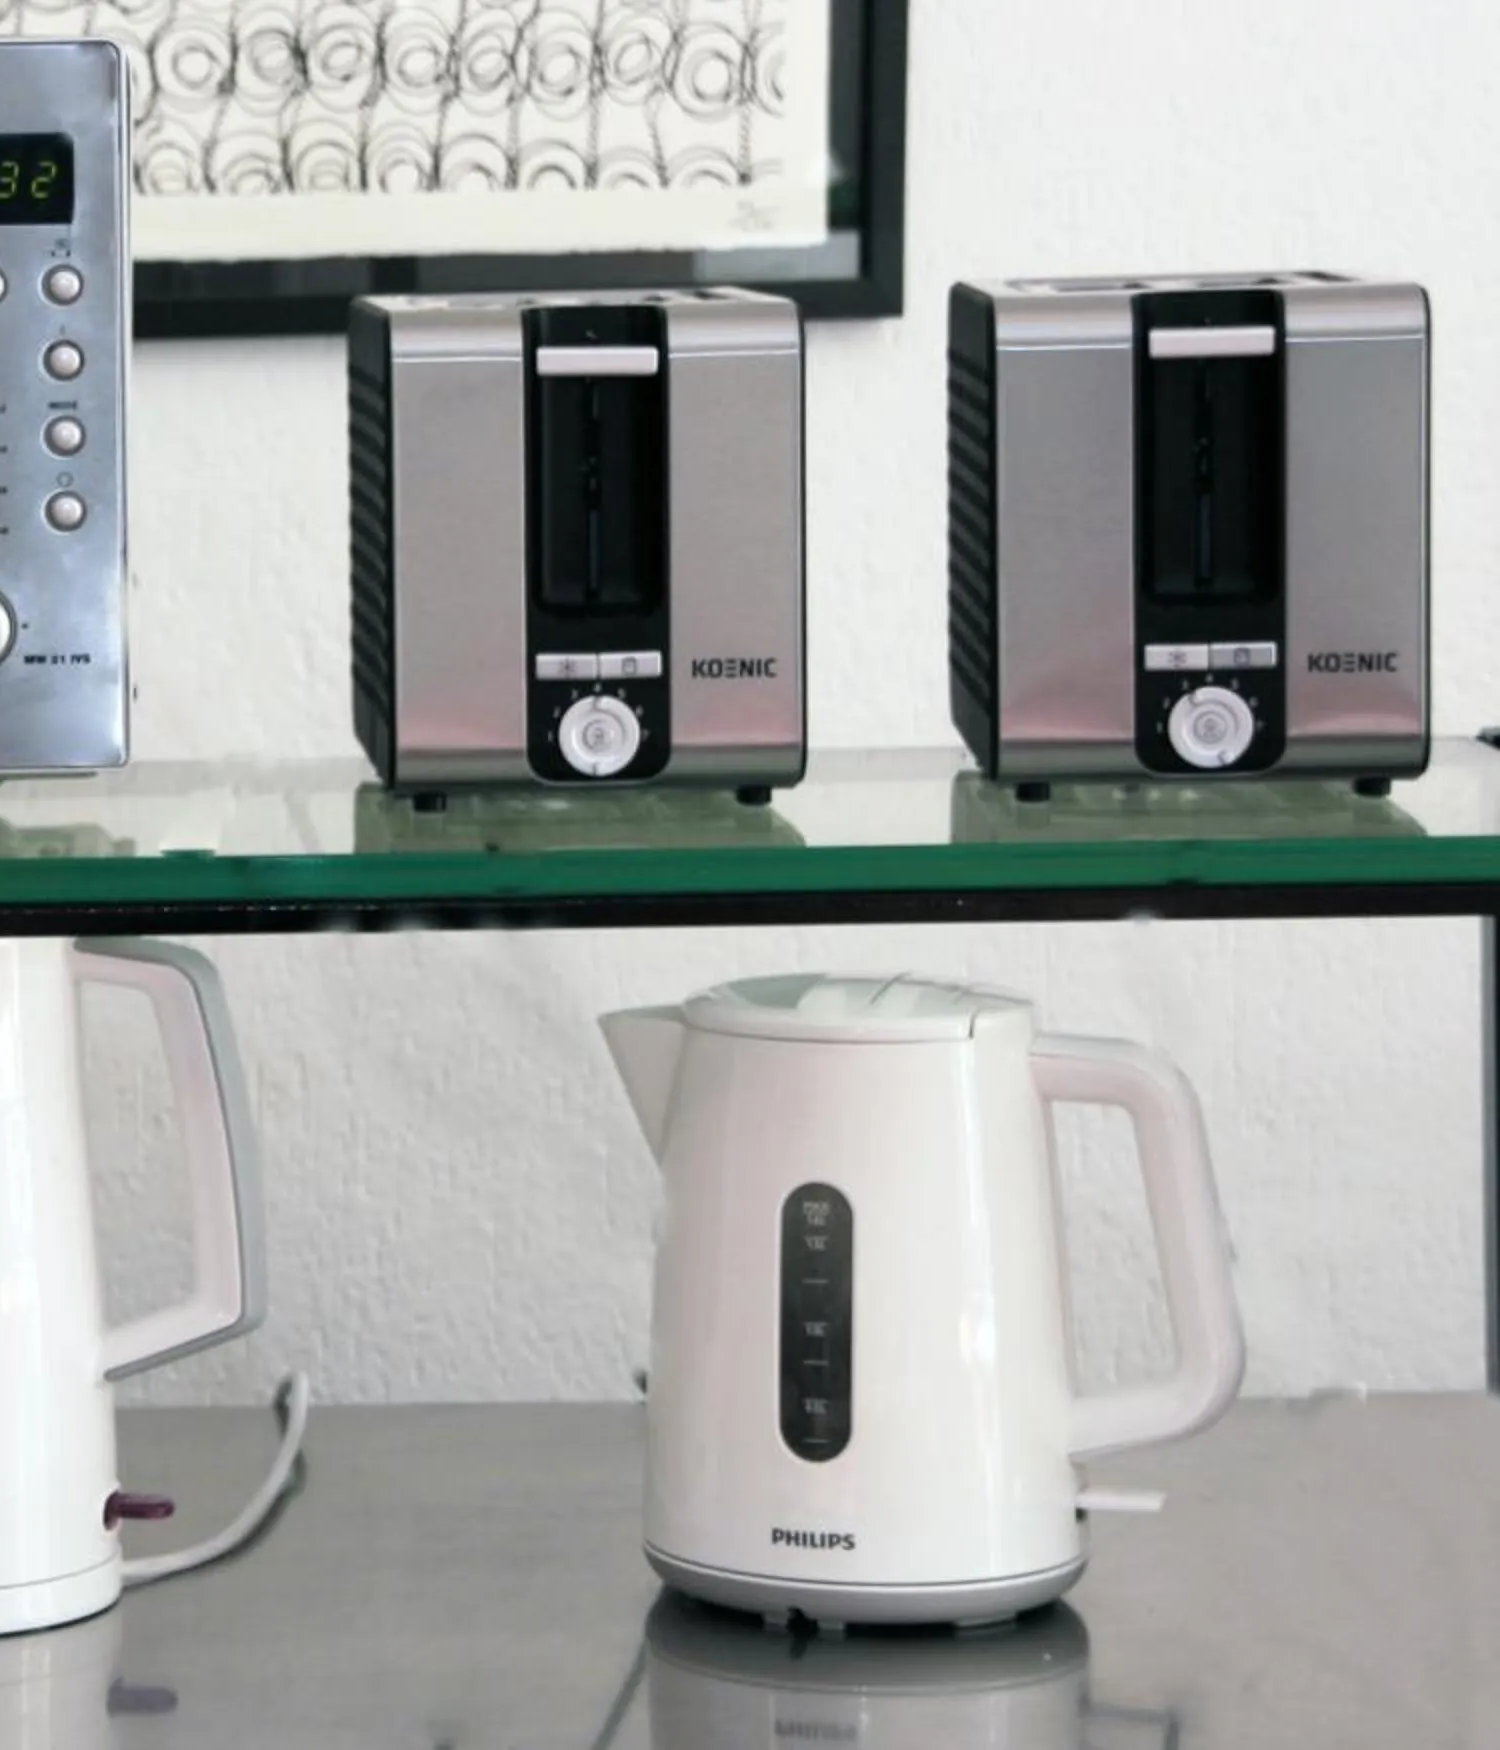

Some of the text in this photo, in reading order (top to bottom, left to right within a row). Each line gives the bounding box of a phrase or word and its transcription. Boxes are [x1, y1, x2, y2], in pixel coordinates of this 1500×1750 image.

[691, 657, 778, 679] KOENIC
[1307, 652, 1398, 673] KOENIC
[771, 1528, 856, 1550] PHILIPS
